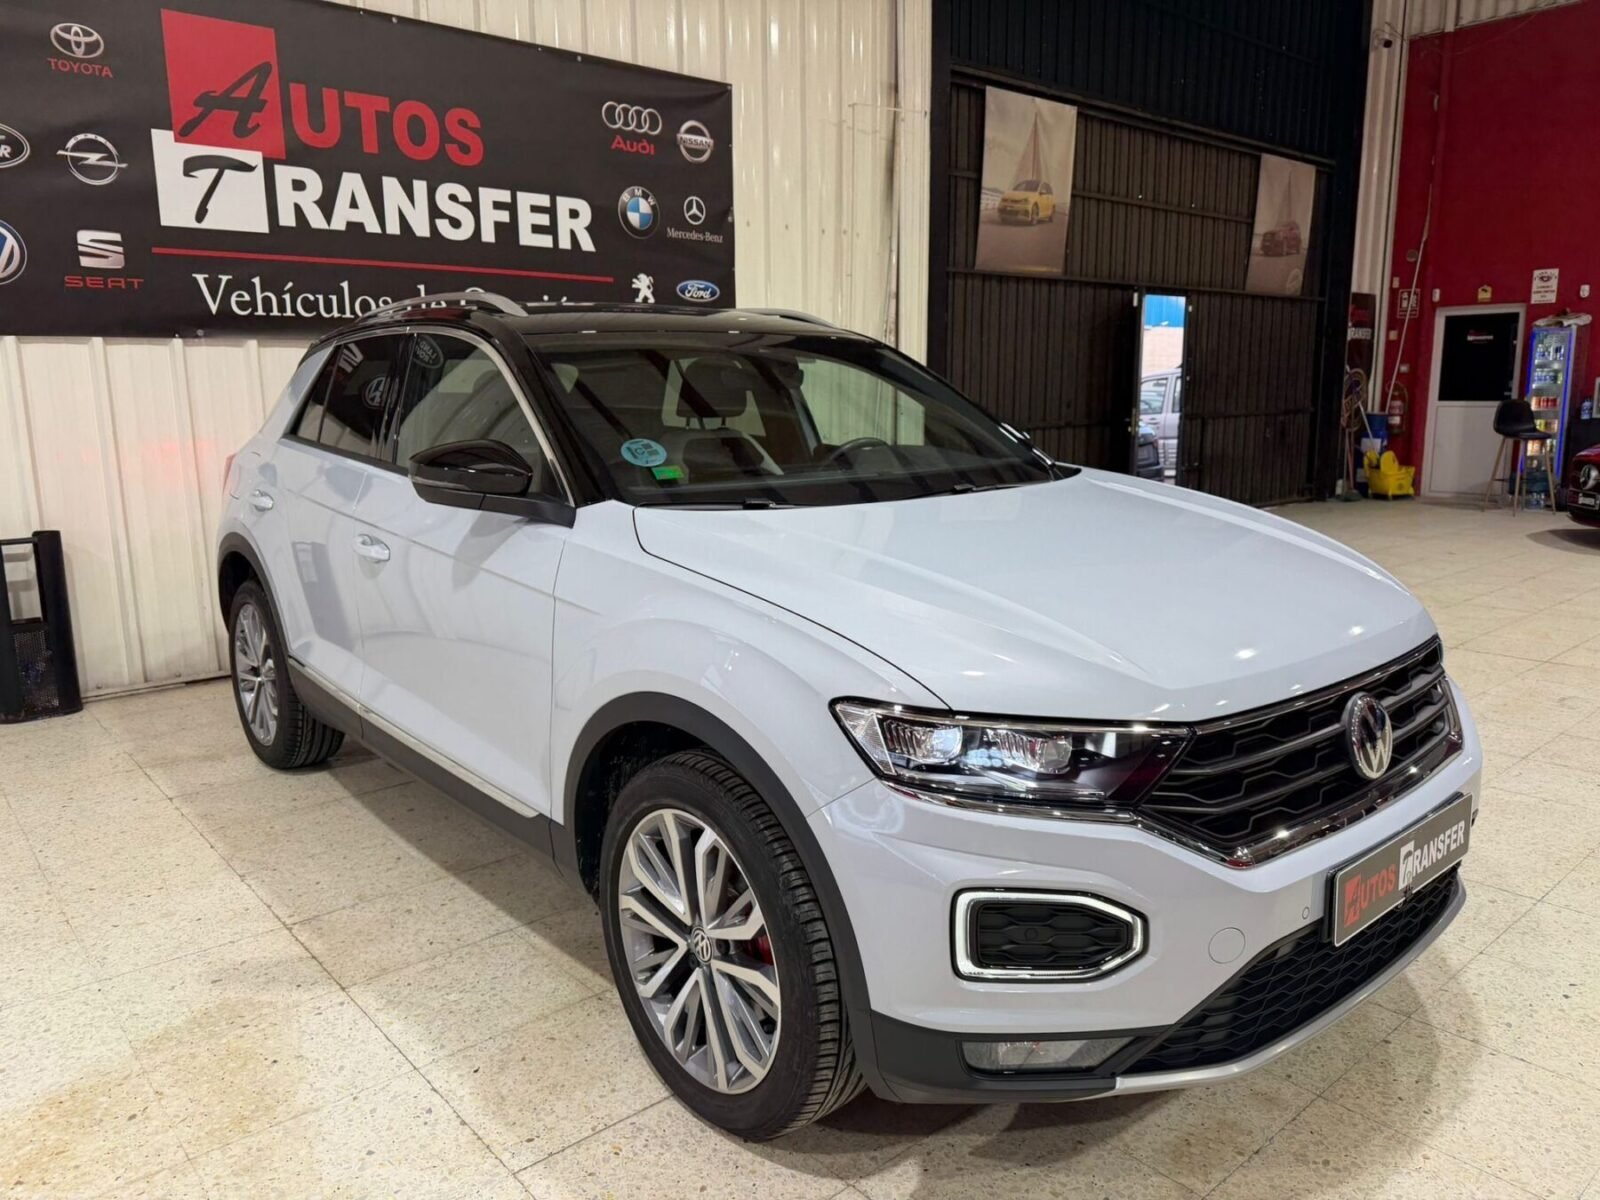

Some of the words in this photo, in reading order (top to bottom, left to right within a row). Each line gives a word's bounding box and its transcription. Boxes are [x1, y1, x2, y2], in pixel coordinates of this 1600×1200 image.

[47, 58, 113, 78] TOYOTA
[179, 61, 485, 167] AUTOS
[611, 134, 655, 155] Audi
[680, 135, 711, 148] NISSAN
[182, 154, 597, 253] TRANSFER
[622, 188, 657, 206] BMW
[666, 227, 724, 243] Mercedes-Benz
[64, 275, 145, 289] SEAT
[684, 283, 712, 299] Ford
[1345, 863, 1397, 927] AUTOS
[1400, 821, 1466, 886] TRANSFER
